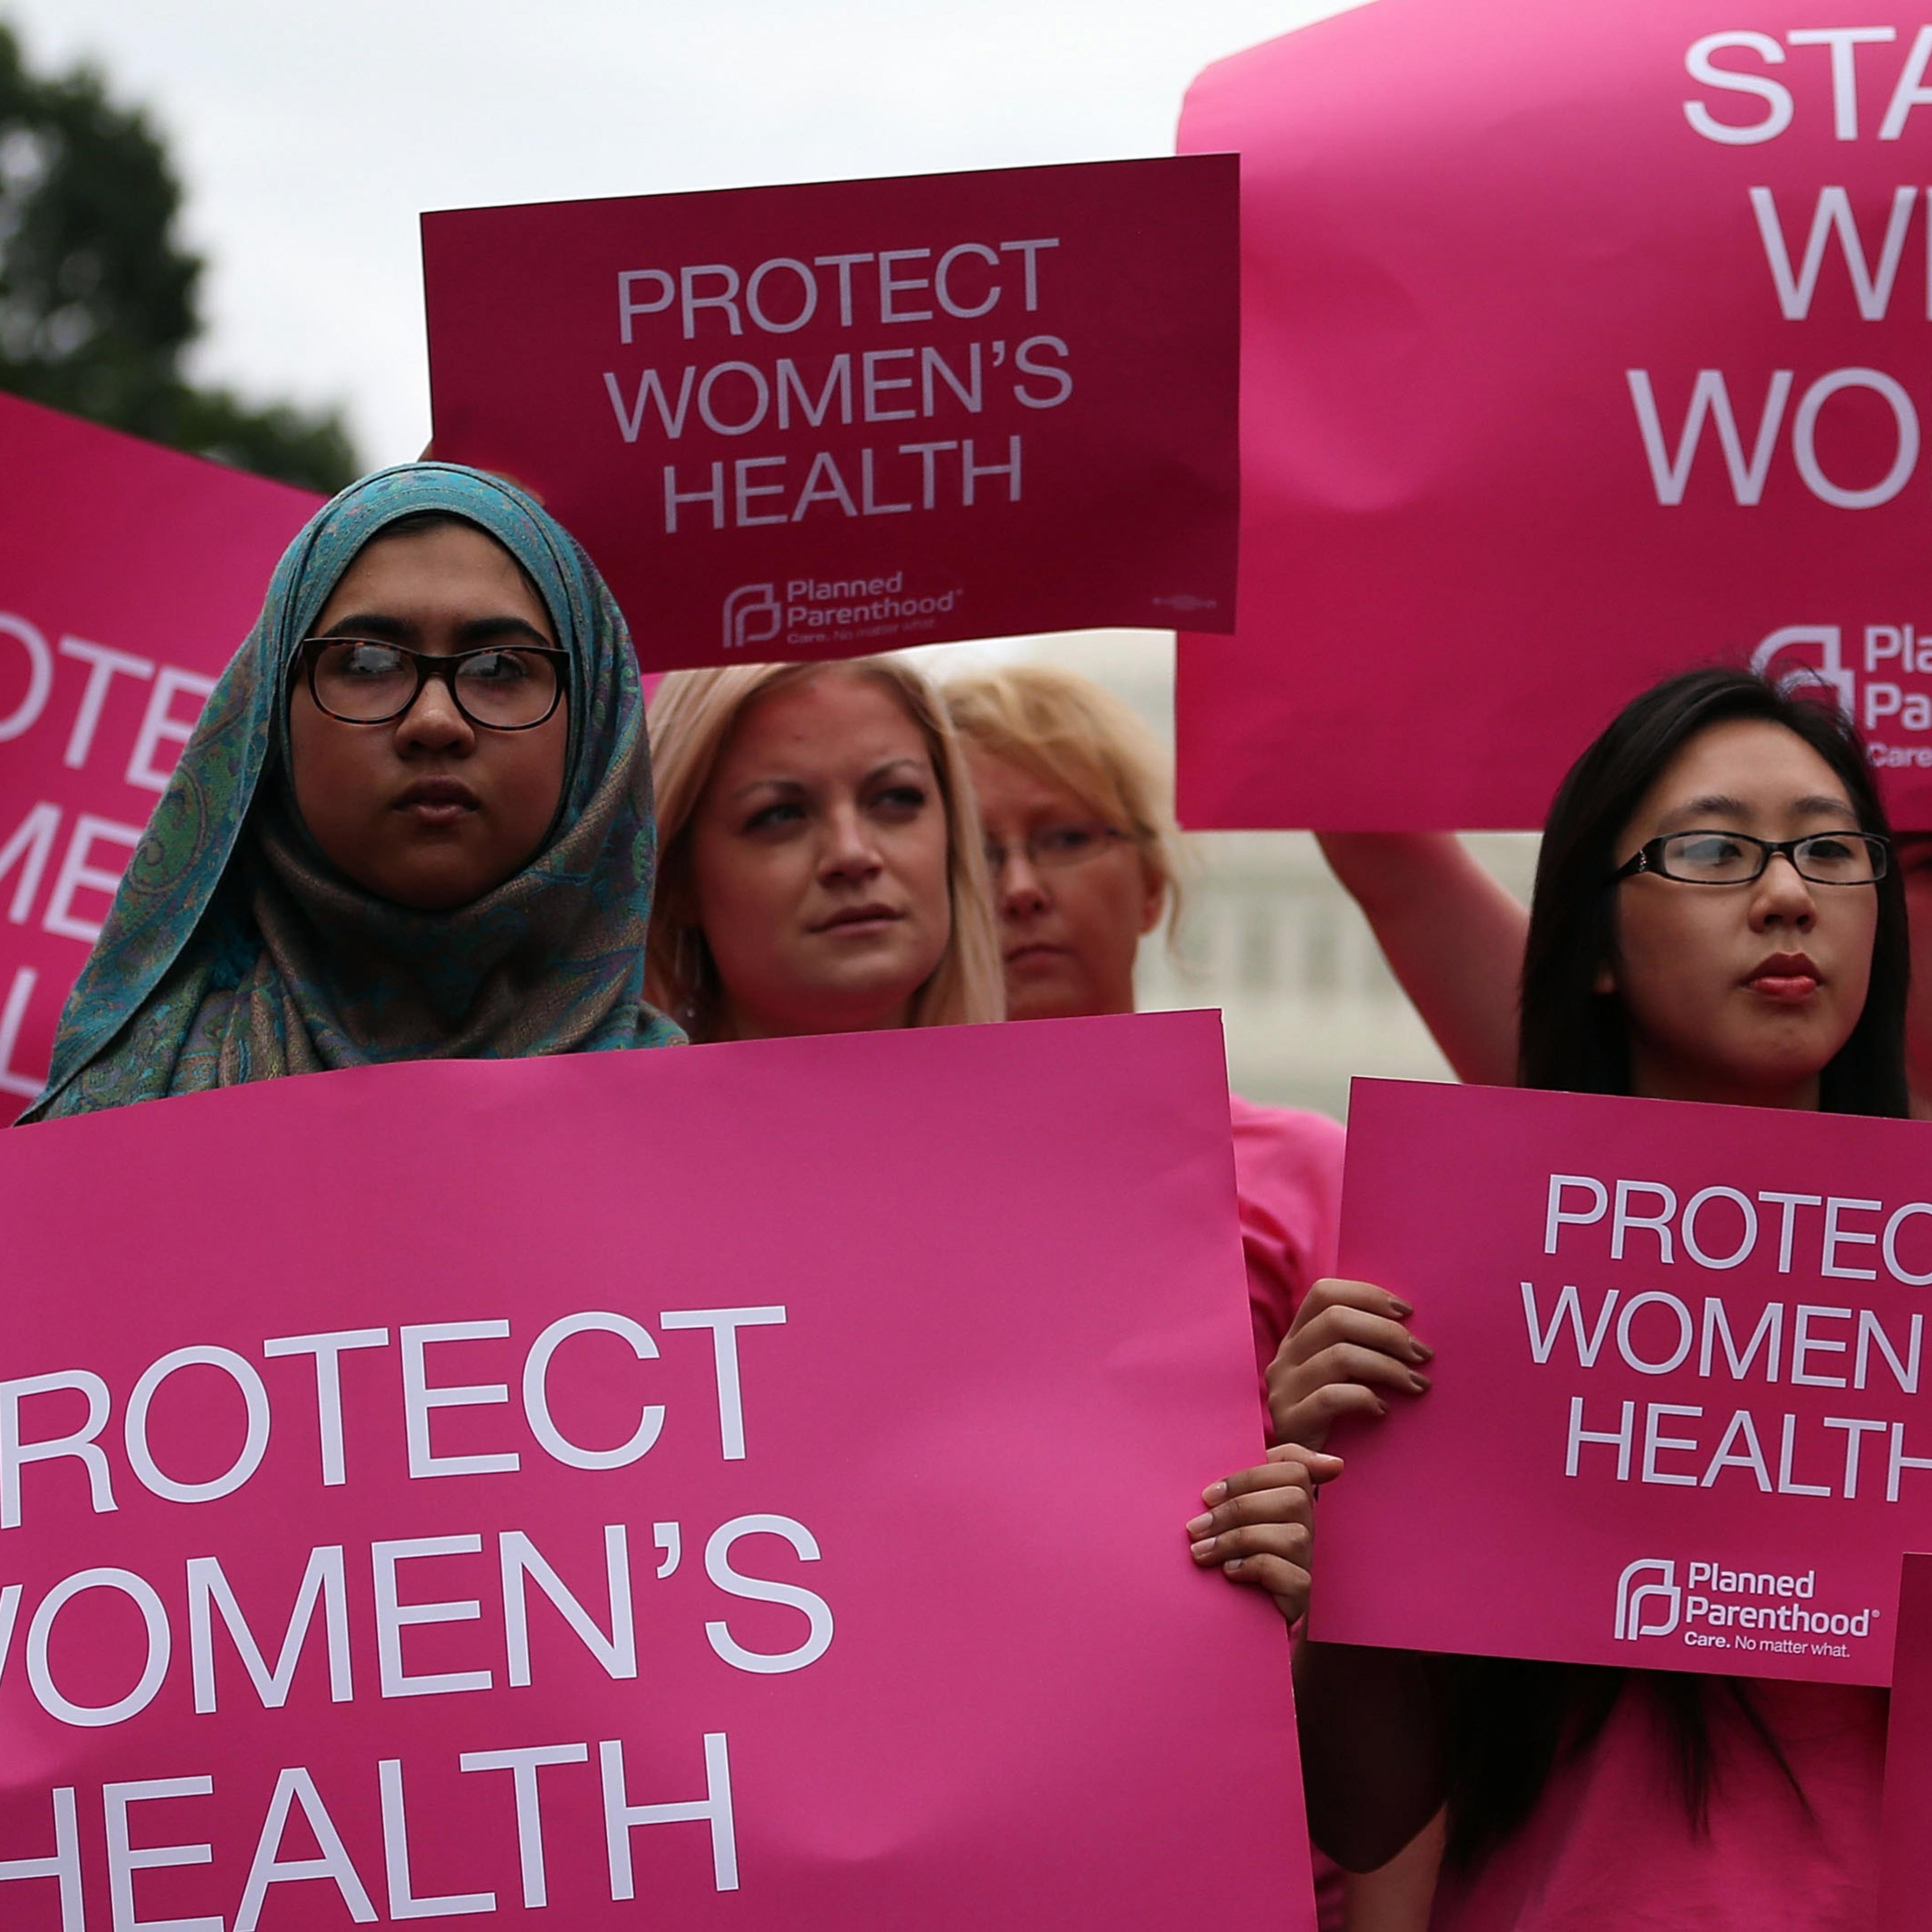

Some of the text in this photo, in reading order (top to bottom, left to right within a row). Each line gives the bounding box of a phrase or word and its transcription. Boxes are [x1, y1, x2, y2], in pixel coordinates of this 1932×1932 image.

[617, 237, 1060, 344] PROTECT
[603, 335, 1073, 443] WOMEN'S
[1626, 367, 1920, 509] WO
[663, 435, 1021, 534] HEALTH
[787, 570, 903, 602] Planned
[1865, 682, 1932, 730] Pa
[1544, 1173, 1932, 1286] PROTEC
[1520, 1281, 1923, 1394] WOMEN
[0, 1305, 787, 1530] ROTECT
[1565, 1396, 1932, 1502] HEALTH
[0, 1513, 834, 1727] OMEN'S
[1688, 1561, 1815, 1598] Planned
[1684, 1631, 1850, 1658] Care. No matter what.
